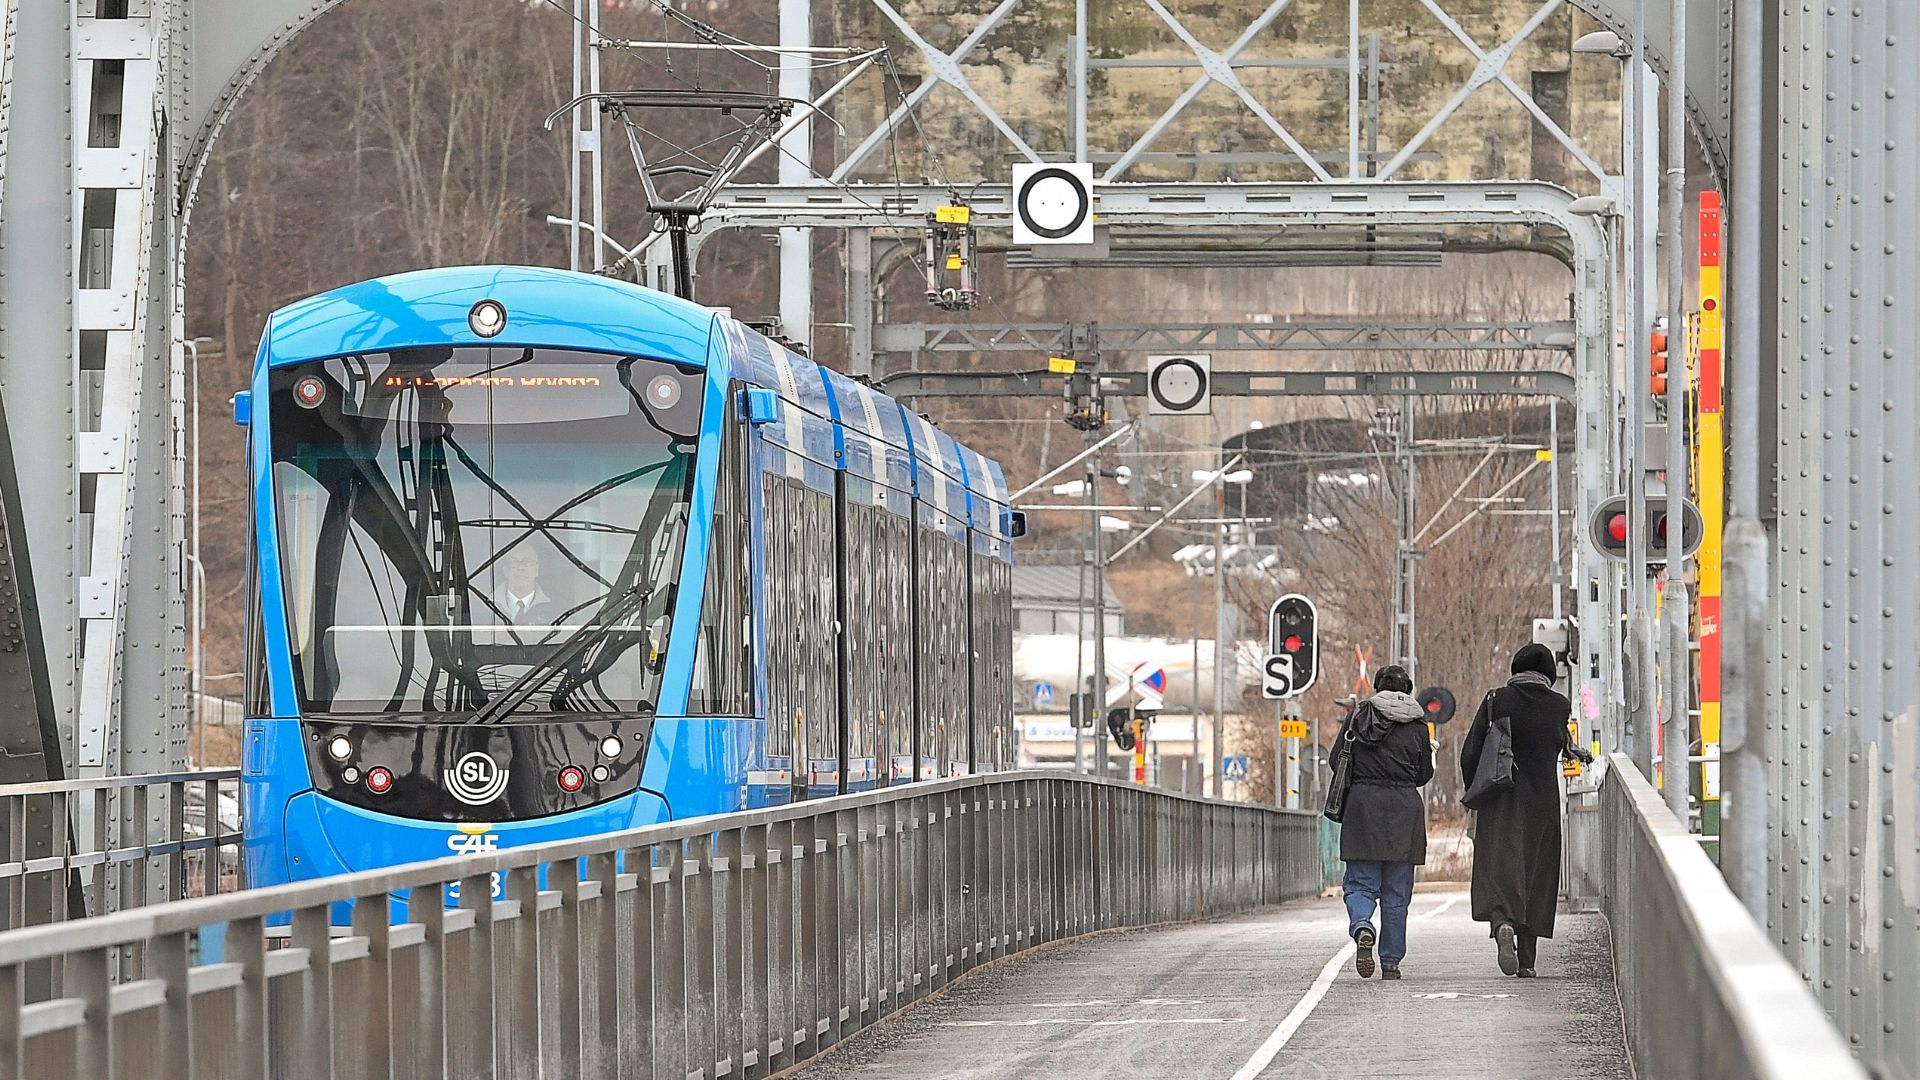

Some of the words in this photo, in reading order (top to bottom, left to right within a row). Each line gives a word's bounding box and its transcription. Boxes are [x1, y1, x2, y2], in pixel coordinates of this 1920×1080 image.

[1265, 657, 1290, 696] S
[1281, 724, 1300, 733] 011
[463, 762, 490, 782] SL
